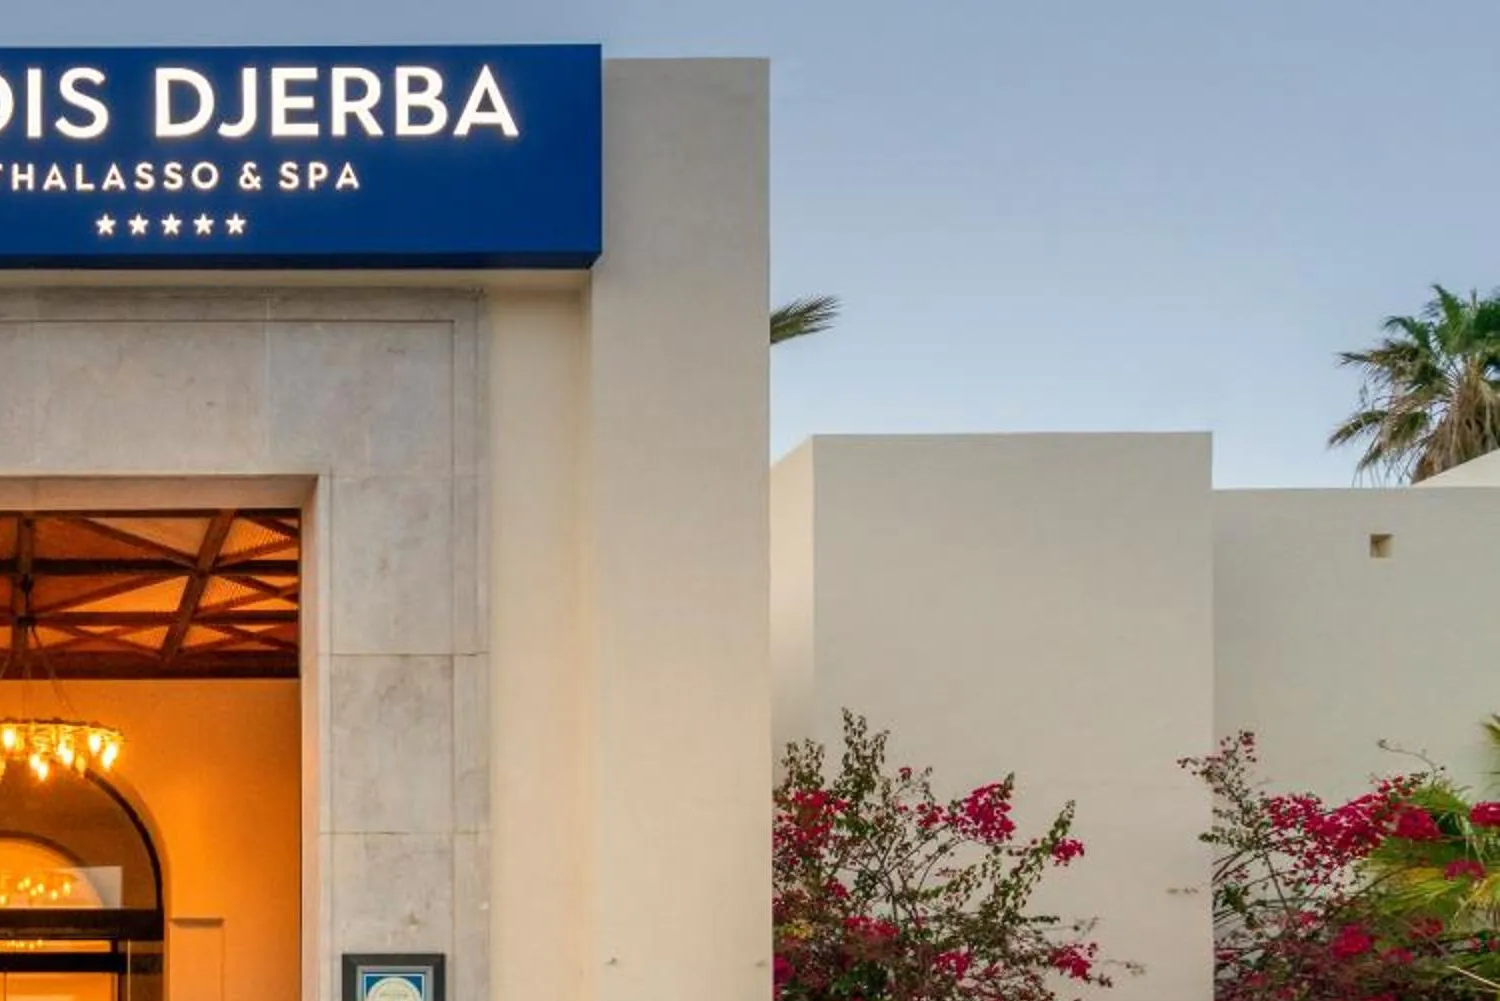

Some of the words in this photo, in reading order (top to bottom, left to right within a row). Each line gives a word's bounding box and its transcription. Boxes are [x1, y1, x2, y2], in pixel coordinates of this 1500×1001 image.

[156, 65, 518, 138] DJERBA
[240, 162, 261, 190] &
[279, 162, 360, 190] SPA
